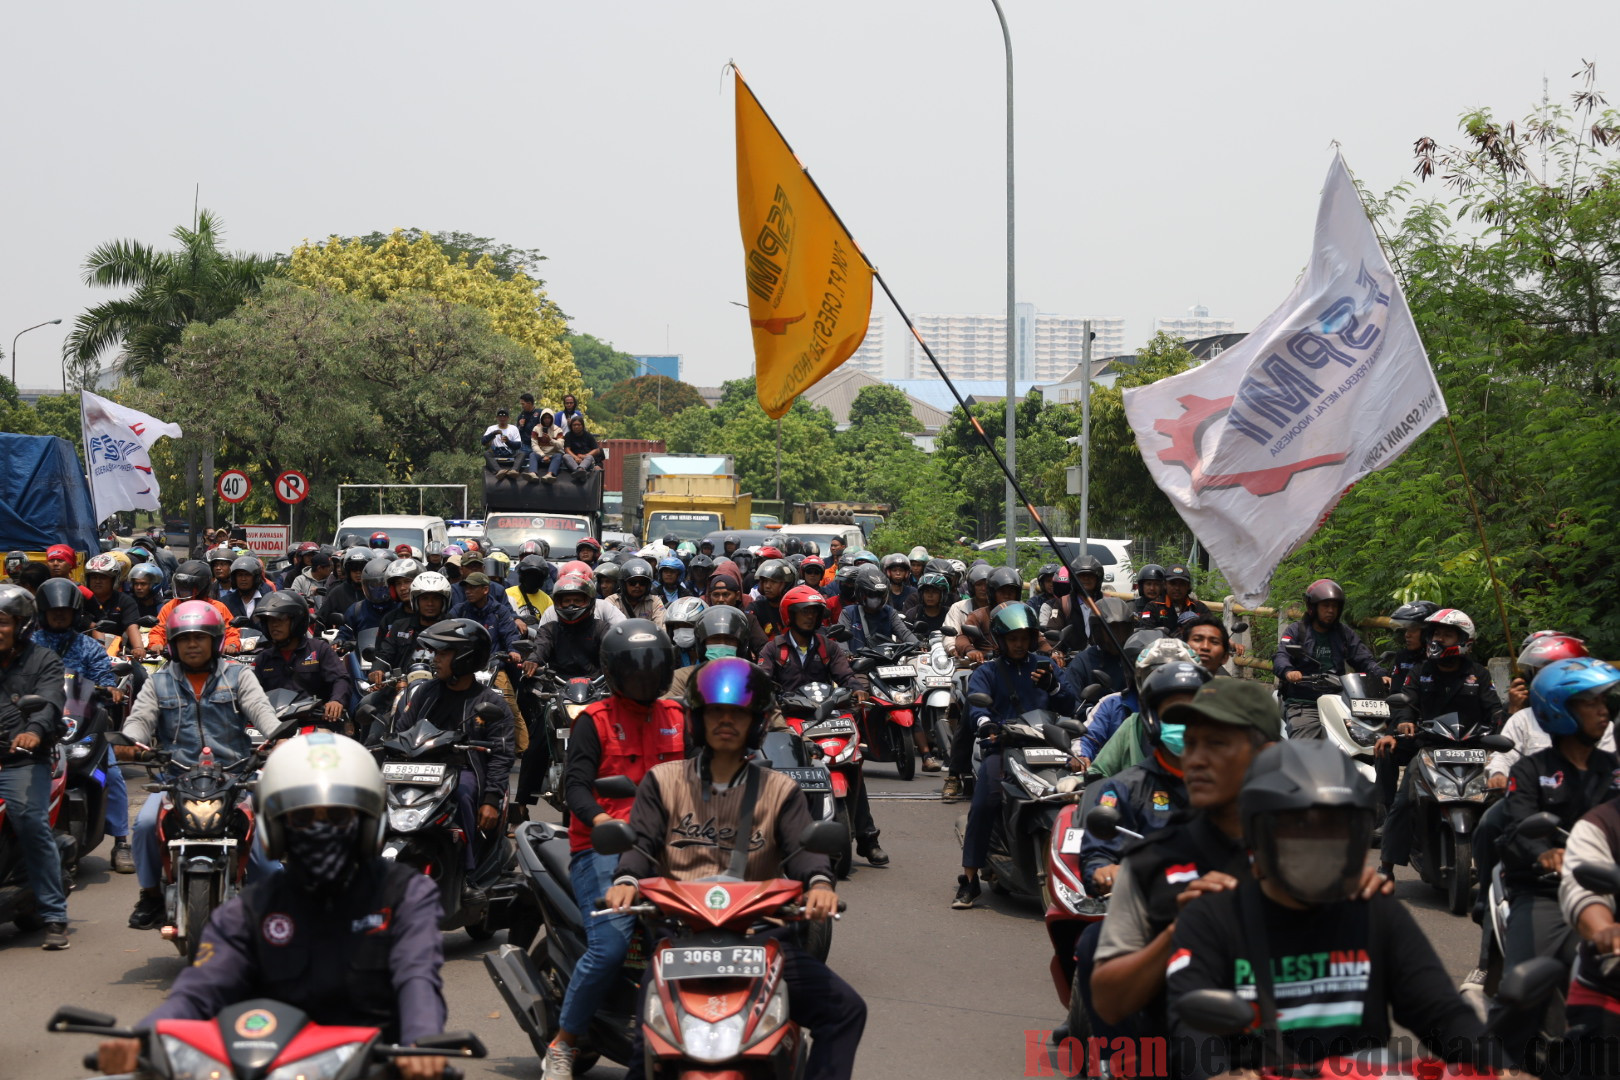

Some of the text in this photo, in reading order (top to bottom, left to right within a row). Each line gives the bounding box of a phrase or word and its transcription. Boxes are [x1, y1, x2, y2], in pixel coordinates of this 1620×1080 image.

[223, 478, 239, 496] 40
[286, 476, 300, 498] P
[497, 518, 579, 531] GARDA METAL
[248, 541, 284, 551] YUNDAI
[804, 770, 823, 780] FIK
[672, 813, 765, 843] Lakes
[664, 948, 763, 964] B 3068 FZN
